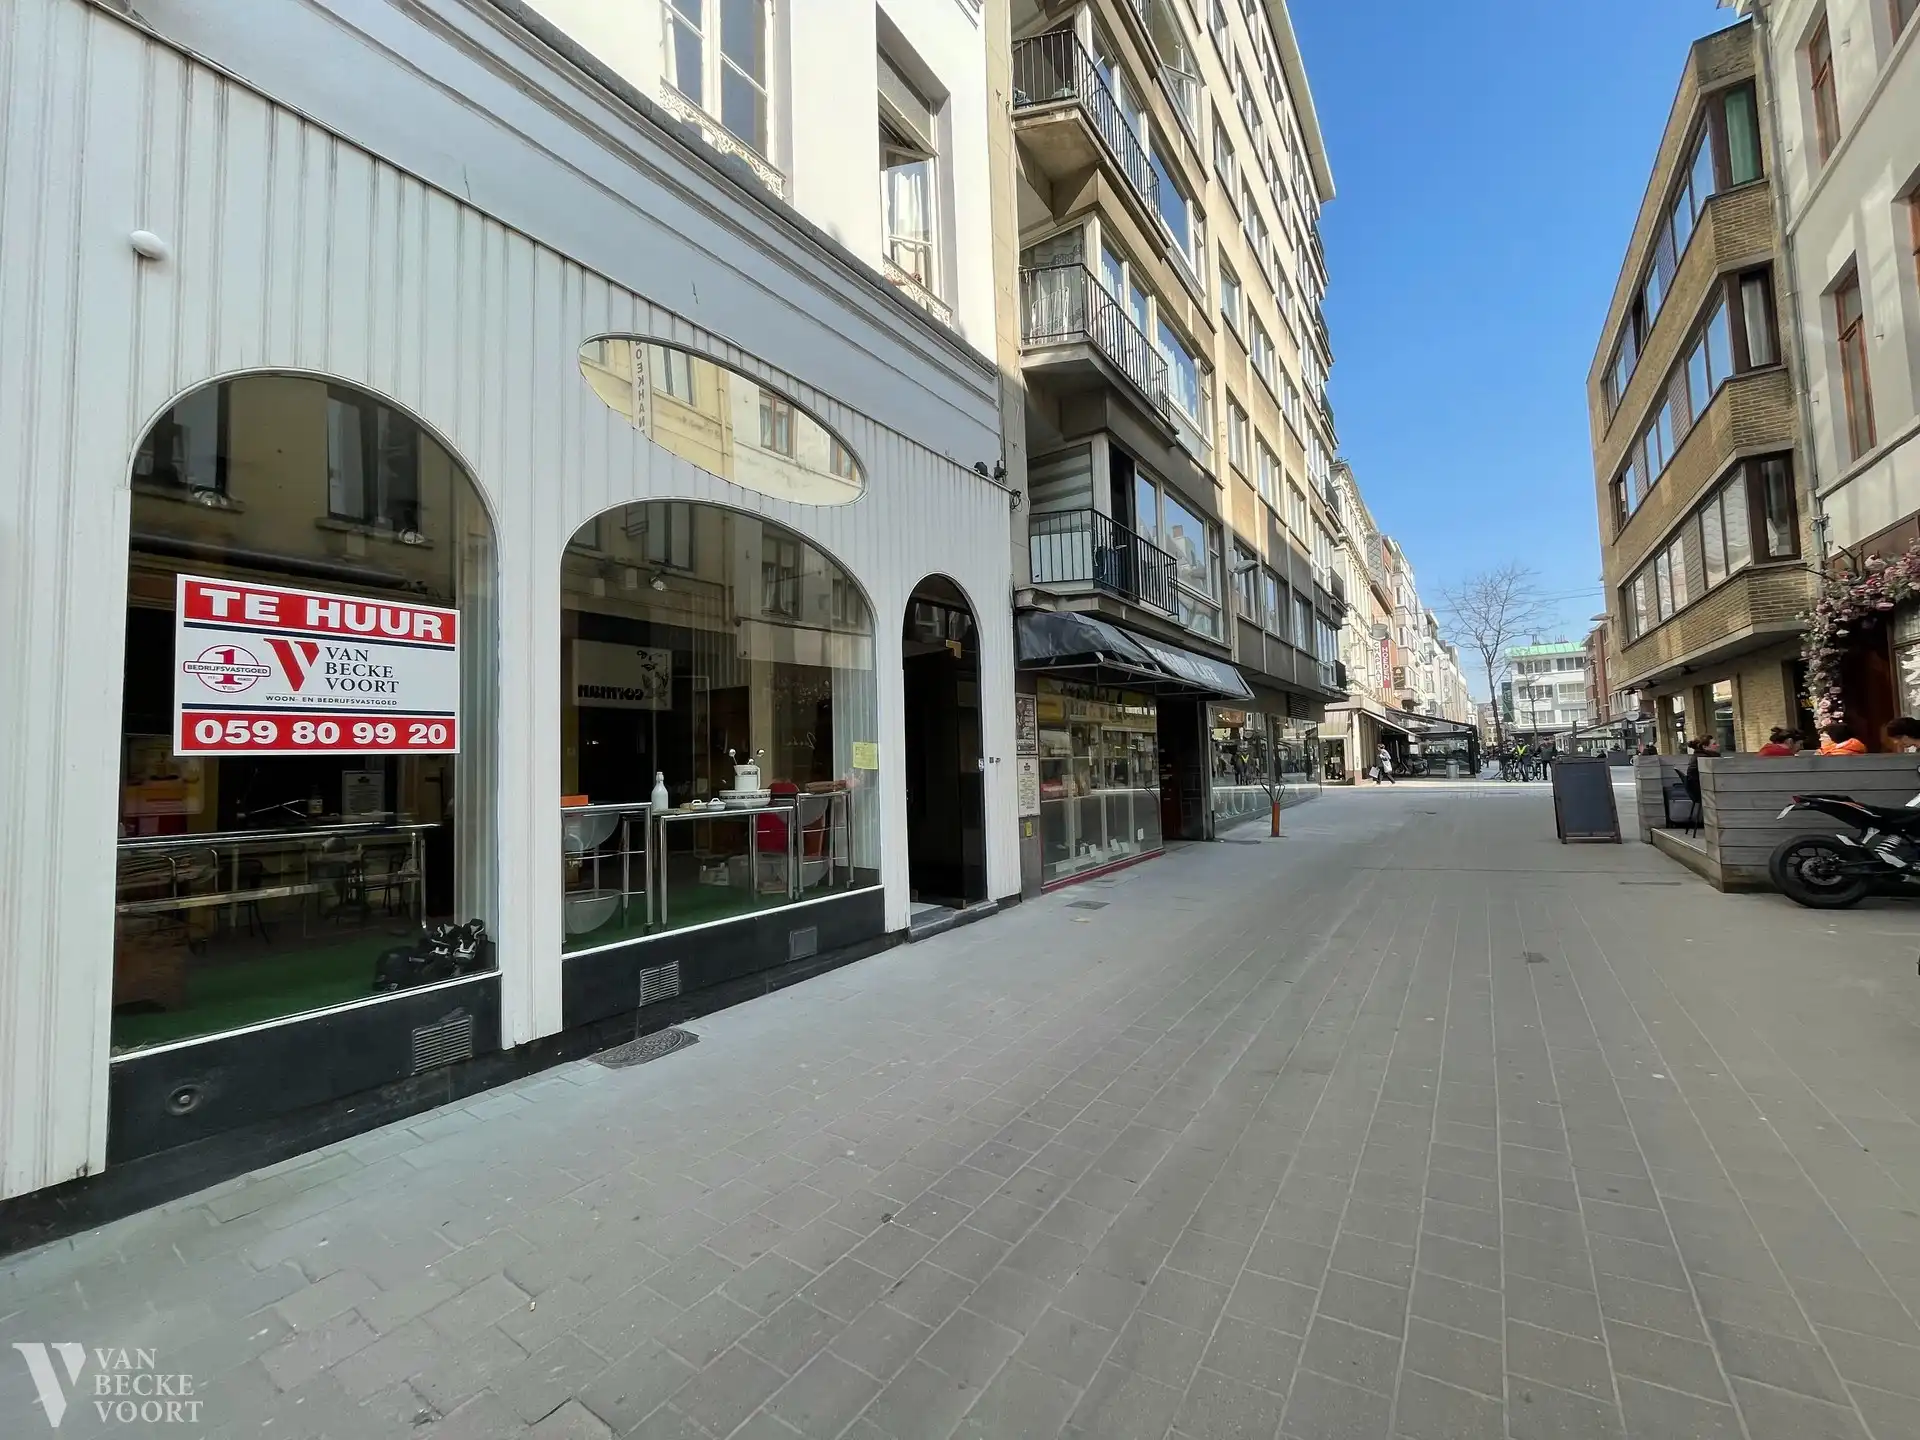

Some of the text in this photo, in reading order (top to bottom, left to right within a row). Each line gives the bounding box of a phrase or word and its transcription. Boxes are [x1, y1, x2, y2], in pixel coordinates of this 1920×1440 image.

[200, 588, 442, 640] TE HUUR
[326, 646, 368, 662] VAN
[187, 664, 268, 674] BEDRIJFSVASTGOED
[325, 662, 394, 678] BECKE
[1373, 641, 1382, 687] CHAPEAUX
[1382, 646, 1390, 681] HOEDEN
[326, 677, 400, 694] VOORT
[317, 697, 397, 706] BEDRIJFSVASTGOED
[195, 719, 447, 745] 059 80 99 20
